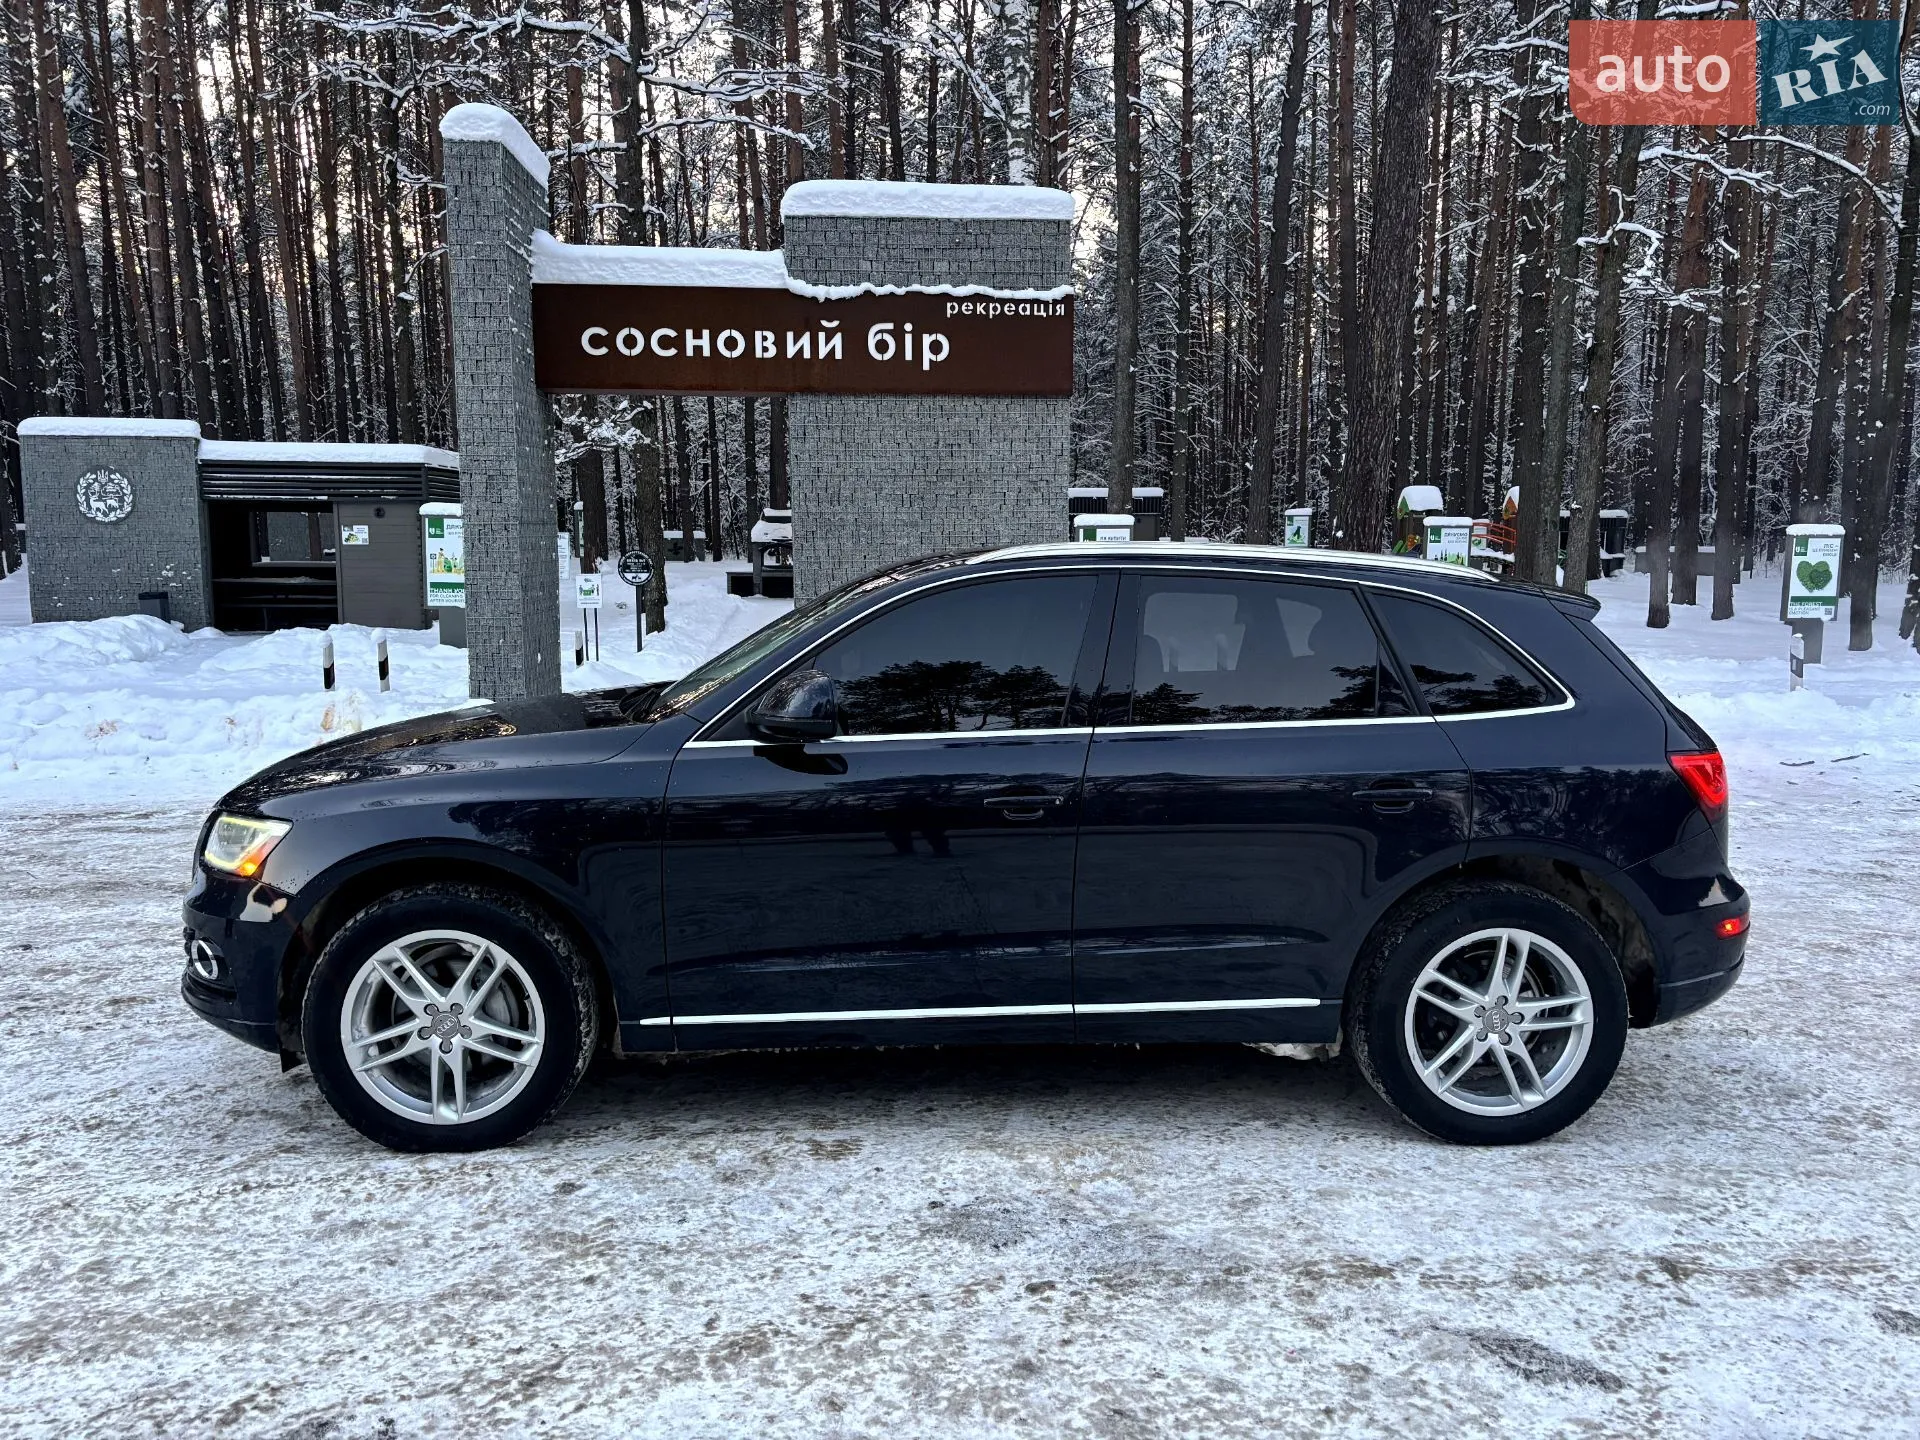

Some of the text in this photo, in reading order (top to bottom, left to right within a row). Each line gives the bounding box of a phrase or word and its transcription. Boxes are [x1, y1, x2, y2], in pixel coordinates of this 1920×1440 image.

[946, 301, 1066, 319] рекреація
[581, 319, 950, 371] сосновий бір
